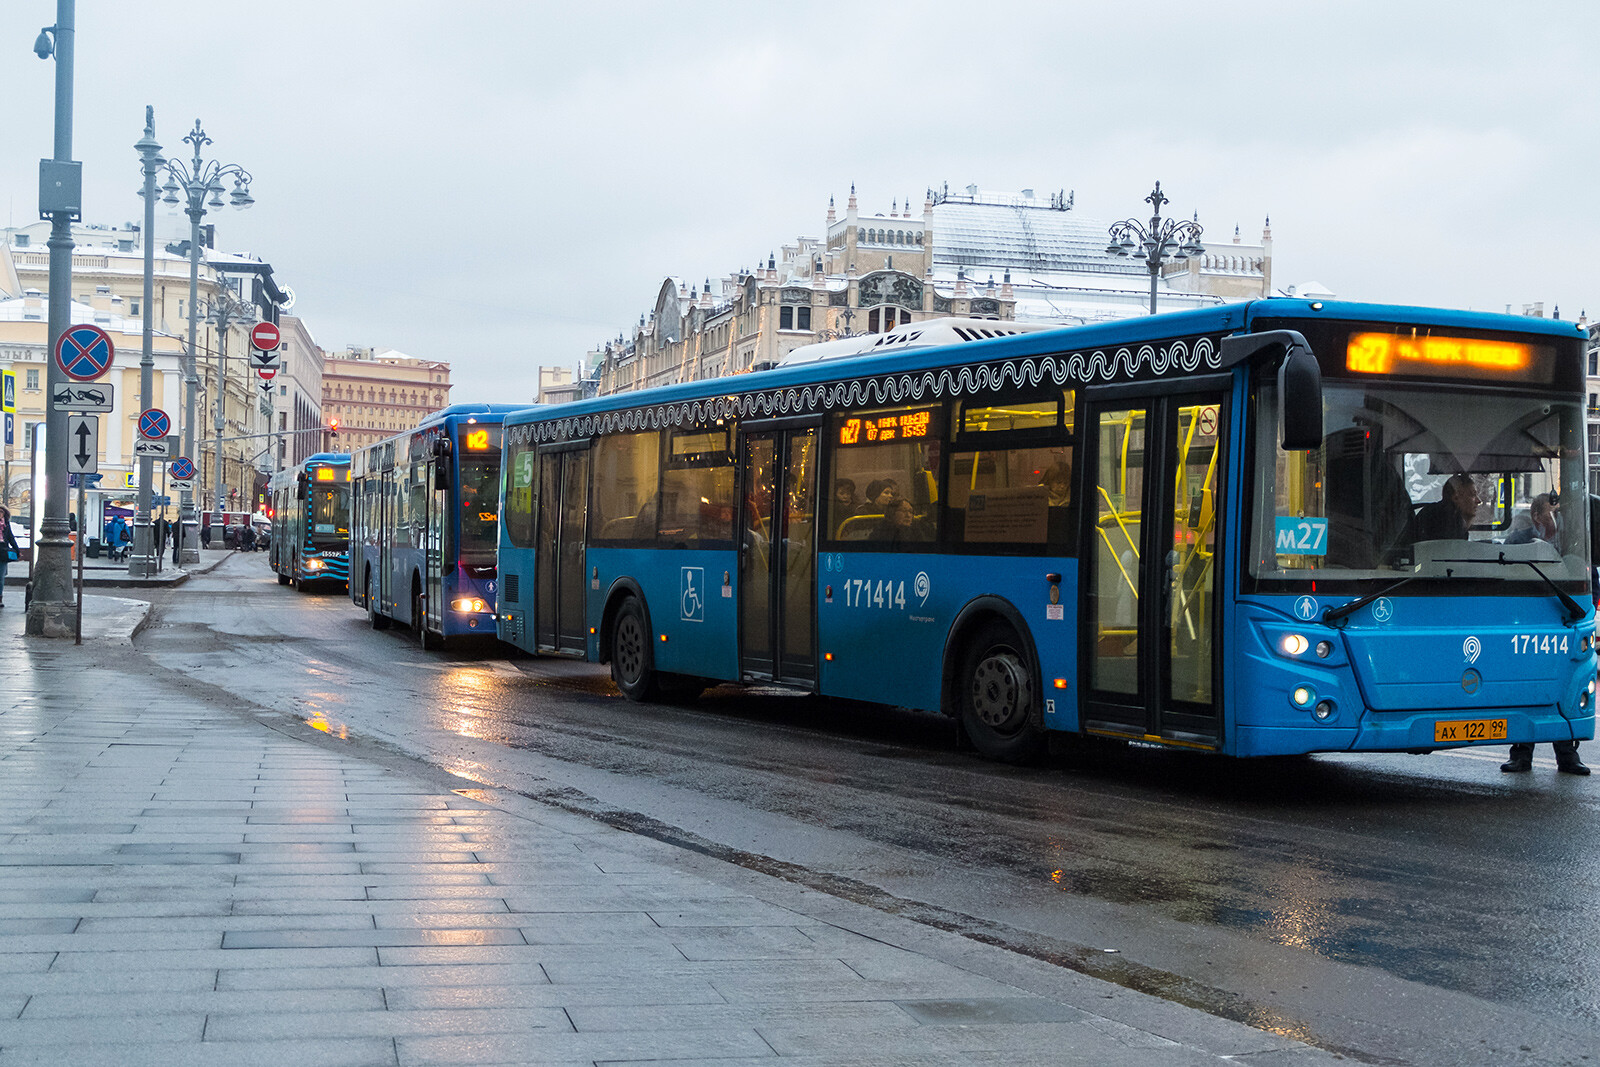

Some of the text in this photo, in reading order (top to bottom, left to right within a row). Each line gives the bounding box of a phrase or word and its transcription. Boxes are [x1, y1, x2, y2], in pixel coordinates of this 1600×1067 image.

[843, 578, 906, 610] 171414
[1511, 634, 1569, 654] 171414
[1462, 722, 1485, 738] 122
[1491, 720, 1504, 733] 99
